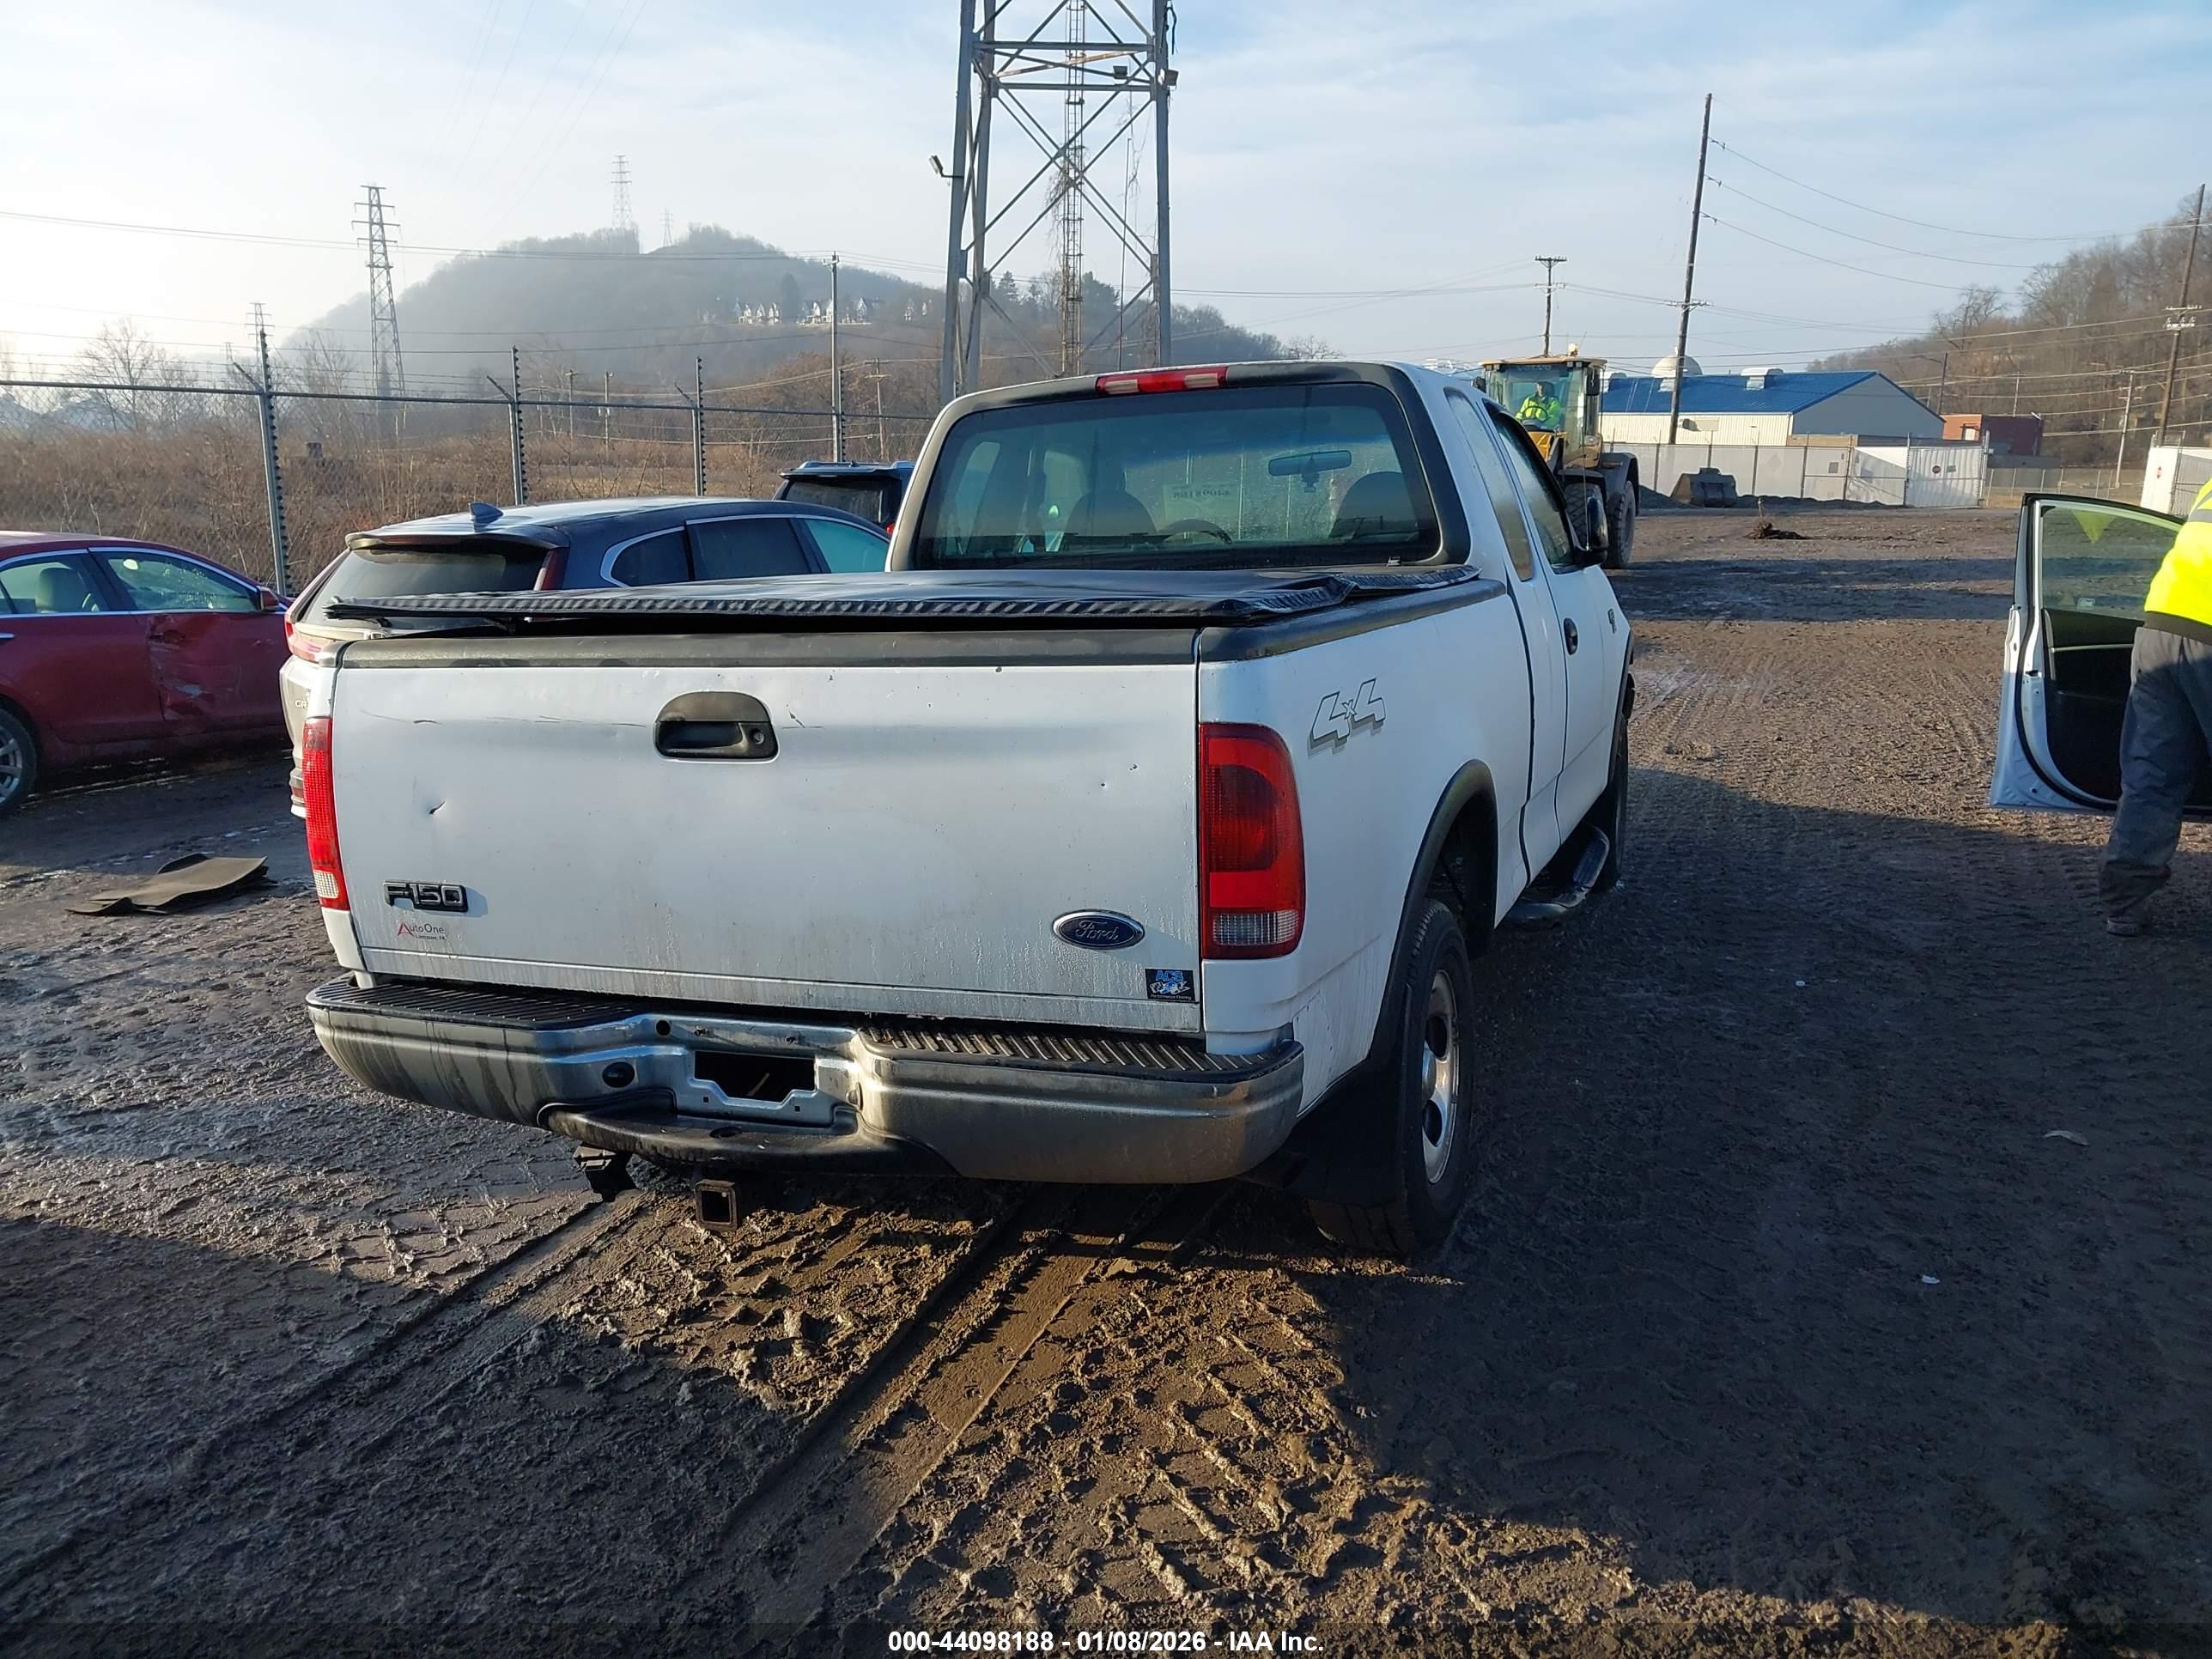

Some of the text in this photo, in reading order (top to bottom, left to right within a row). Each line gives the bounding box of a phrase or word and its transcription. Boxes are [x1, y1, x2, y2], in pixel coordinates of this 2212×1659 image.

[1310, 678, 1386, 745] 4x4
[384, 882, 464, 907] F-150
[398, 921, 446, 938] AutoOne
[1074, 920, 1121, 941] Ford
